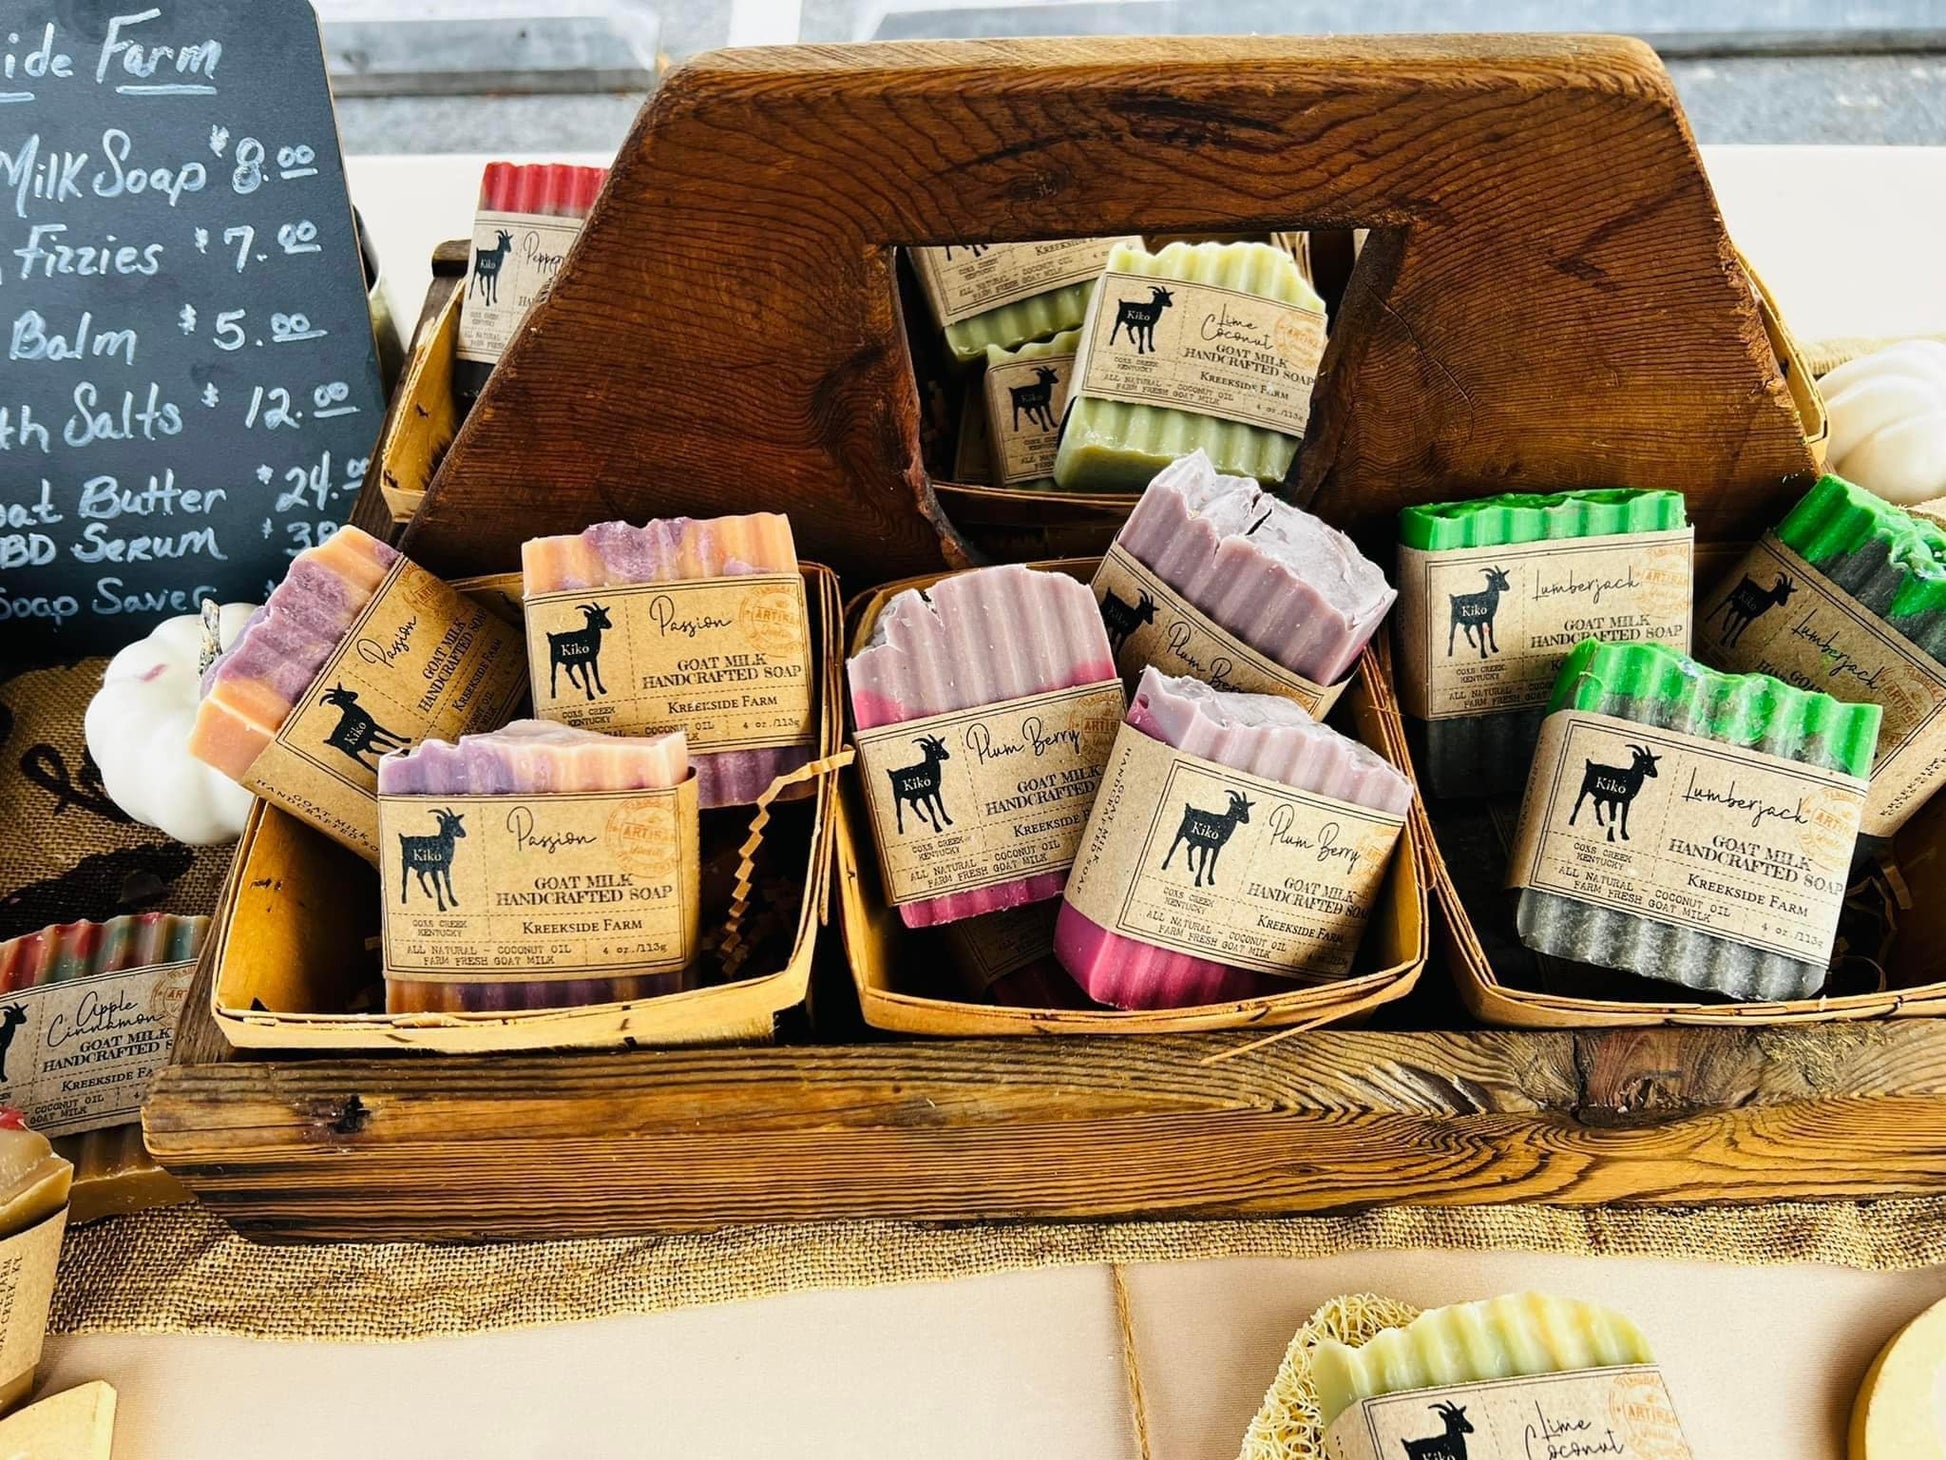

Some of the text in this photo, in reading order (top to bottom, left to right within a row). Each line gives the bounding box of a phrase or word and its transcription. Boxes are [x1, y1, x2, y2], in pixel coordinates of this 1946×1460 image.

[96, 7, 222, 84] Farm
[92, 128, 207, 207] Soap
[13, 224, 164, 281] Fizzies
[1127, 310, 1150, 321] Kiko
[1217, 303, 1260, 330] Lime
[10, 309, 137, 366] Balm
[1201, 314, 1274, 350] Coconut
[1182, 348, 1315, 386] HANDCRAFTED SOAP
[1216, 344, 1289, 369] GOAT MILK
[1104, 374, 1234, 401] ALL NATURAL COCONUT OIL
[1116, 383, 1220, 405] FARM FRESH GOAT MILK
[63, 381, 183, 448] Salts
[78, 467, 227, 519] Butter
[92, 576, 218, 614] Saver
[1531, 564, 1640, 604] Lumberjack
[650, 594, 733, 638] Passion
[1461, 605, 1488, 617] Kiko
[1563, 614, 1651, 631] GOAT MILK
[356, 615, 417, 668] Passion
[422, 647, 448, 680] GOAT
[444, 617, 467, 650] MILK
[561, 642, 590, 657] Kiko
[1167, 621, 1206, 673] Plum
[1531, 624, 1683, 648] HANDCRAFTED SOAP
[1790, 608, 1885, 691] Lumberjack
[418, 632, 475, 713] HANDCRAFTED
[469, 607, 488, 633] SOAP
[677, 653, 768, 672] GOAT MILK
[1480, 664, 1506, 673] CREEK
[642, 664, 802, 690] HANDCRAFTED SOAP
[1461, 674, 1500, 683] KENTUCKY
[1449, 687, 1512, 700] ALL NATURAL
[1464, 694, 1520, 708] FARM FRESH
[344, 720, 367, 746] Kiko
[567, 716, 611, 727] KENTUCKY
[644, 720, 716, 735] COCONUT OIL
[965, 722, 1024, 765] Plum
[1022, 716, 1080, 757] Berry
[903, 776, 931, 792] Kiko
[1017, 765, 1101, 793] GOAT MILK
[1594, 777, 1626, 795] Kiko
[256, 780, 357, 840] HANDCRAFTED
[986, 781, 1095, 816] HANDCRAFTED
[1090, 748, 1132, 852] HANDCRAFTED
[1681, 766, 1808, 827] Lumberjack
[335, 819, 369, 840] MILK
[506, 805, 598, 854] Passion
[937, 836, 964, 848] CREEK
[1190, 822, 1220, 841] Kiko
[1268, 803, 1314, 846] Plum
[1317, 821, 1362, 874] Berry
[412, 849, 443, 863] Kiko
[910, 840, 1060, 881] ALL NATURAL COCONUT OIL
[918, 846, 960, 861] KENTUCKY
[1092, 828, 1108, 866] MILK
[1603, 848, 1633, 864] CREEK
[1712, 834, 1814, 873] GOAT MILK
[928, 853, 1048, 888] FARM FRESH GOAT MILK
[1576, 852, 1625, 872] KENTUCKY
[1668, 838, 1844, 895] HANDCRAFTED SOAP
[534, 873, 634, 890] GOAT MILK
[1284, 877, 1356, 904] GOAT MILK
[1557, 866, 1731, 918] ALL NATURAL COCONUT OIL
[496, 885, 673, 907] HANDCRAFTED SOAP
[1165, 896, 1206, 916] KENTUCKY
[1247, 883, 1343, 915] HANDCRAFTED
[1573, 880, 1711, 924] FARM FRESH GOAT MILK
[417, 929, 463, 937] KENTUCKY
[439, 920, 467, 928] CREEK
[1146, 910, 1287, 953] ALL NATURAL COCONUT OIL
[1761, 922, 1769, 932] 4
[407, 944, 572, 955] ALL NATURAL COCONUT OIL
[602, 946, 609, 955] 4
[1158, 924, 1271, 959] FARM FRESH GOAT MILK
[424, 956, 555, 966] FARM FRESH GOAT MILK
[76, 990, 138, 1027] Apple
[47, 1013, 165, 1048] Cinnamon
[80, 1027, 173, 1053] GOAT MILK
[42, 1041, 160, 1073] HANDCRAFTED
[35, 1095, 105, 1115] COCONUT OIL
[61, 1107, 88, 1118] MILK
[1535, 1400, 1592, 1440] Lime
[1524, 1424, 1625, 1460] Coconut
